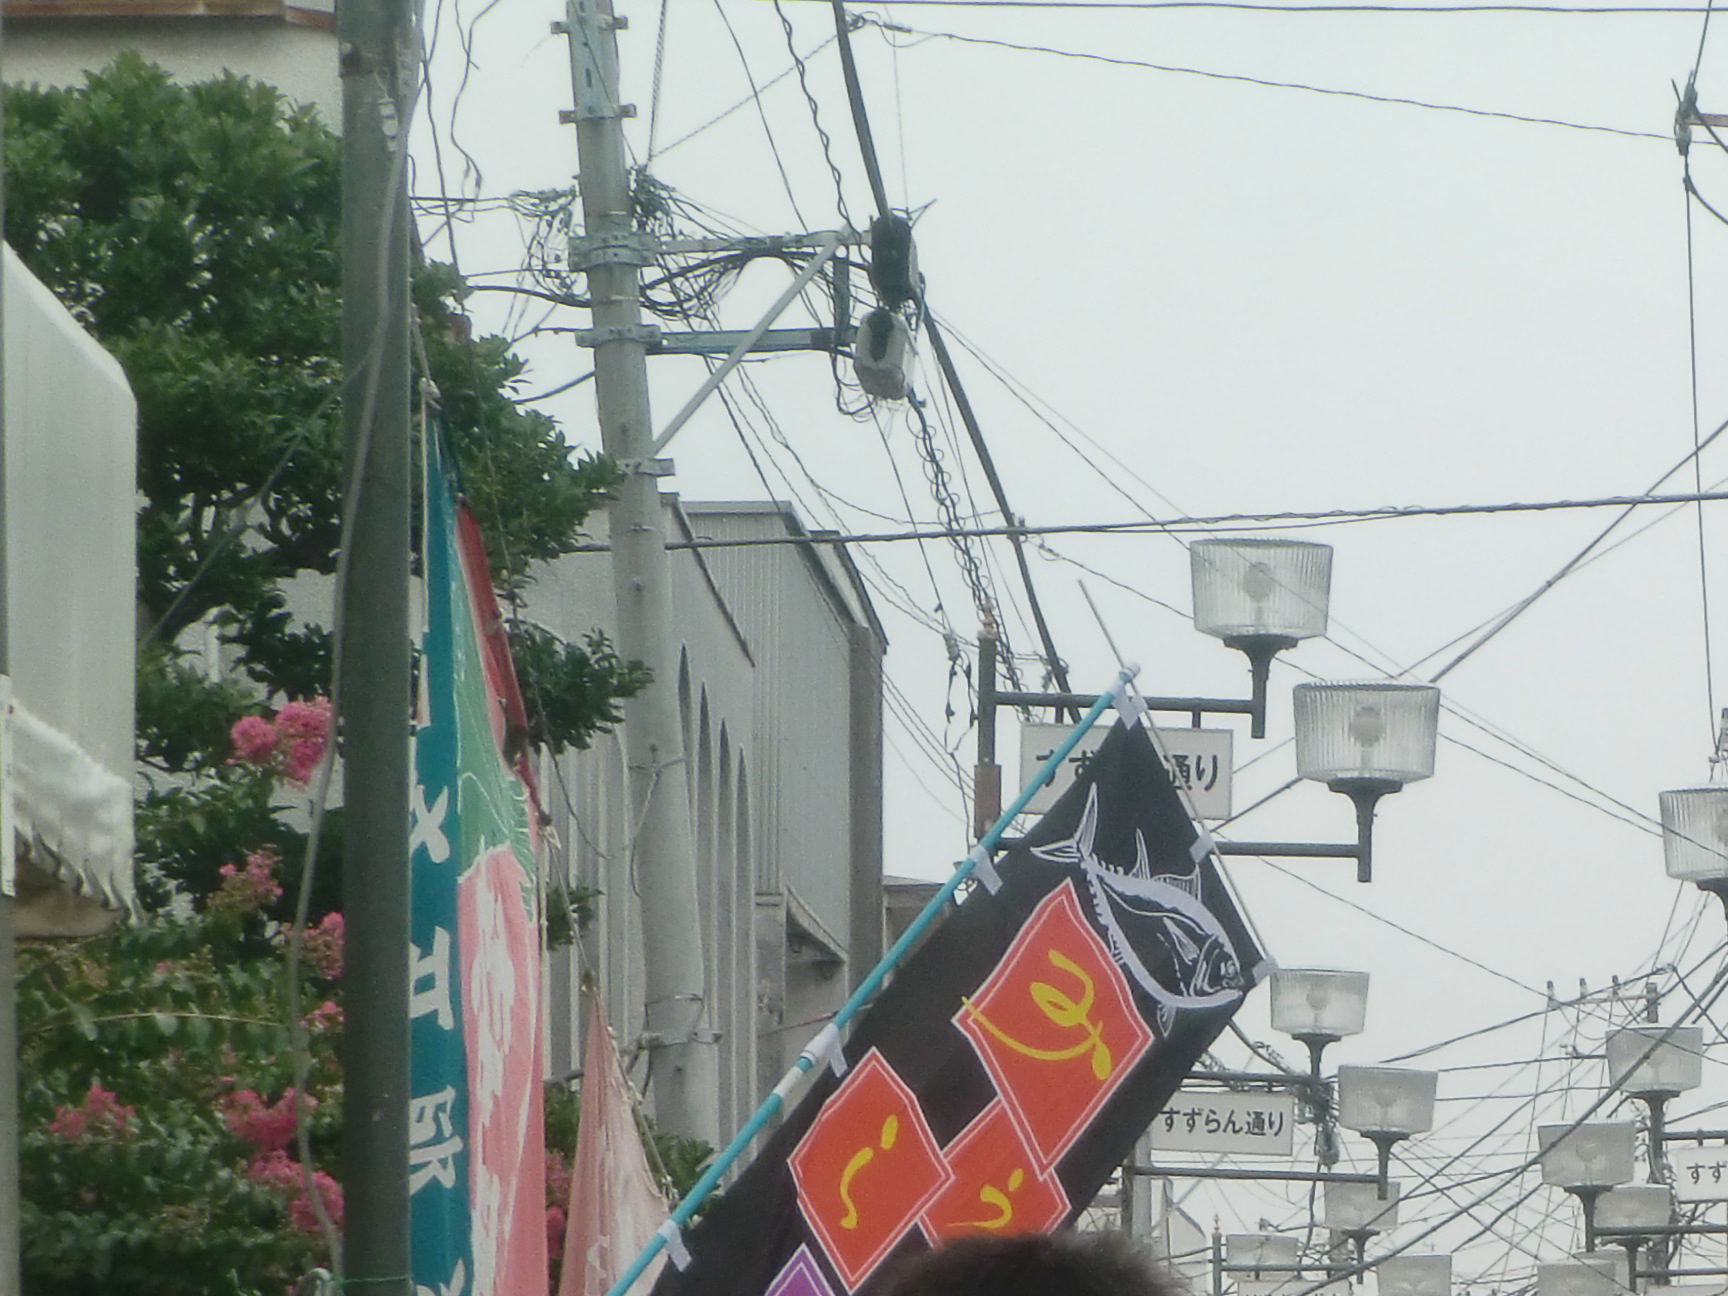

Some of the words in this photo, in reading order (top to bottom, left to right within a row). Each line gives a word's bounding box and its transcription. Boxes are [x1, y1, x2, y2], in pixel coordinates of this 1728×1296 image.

[1035, 749, 1218, 792] すず通り
[1160, 1105, 1285, 1137] すずらん通り
